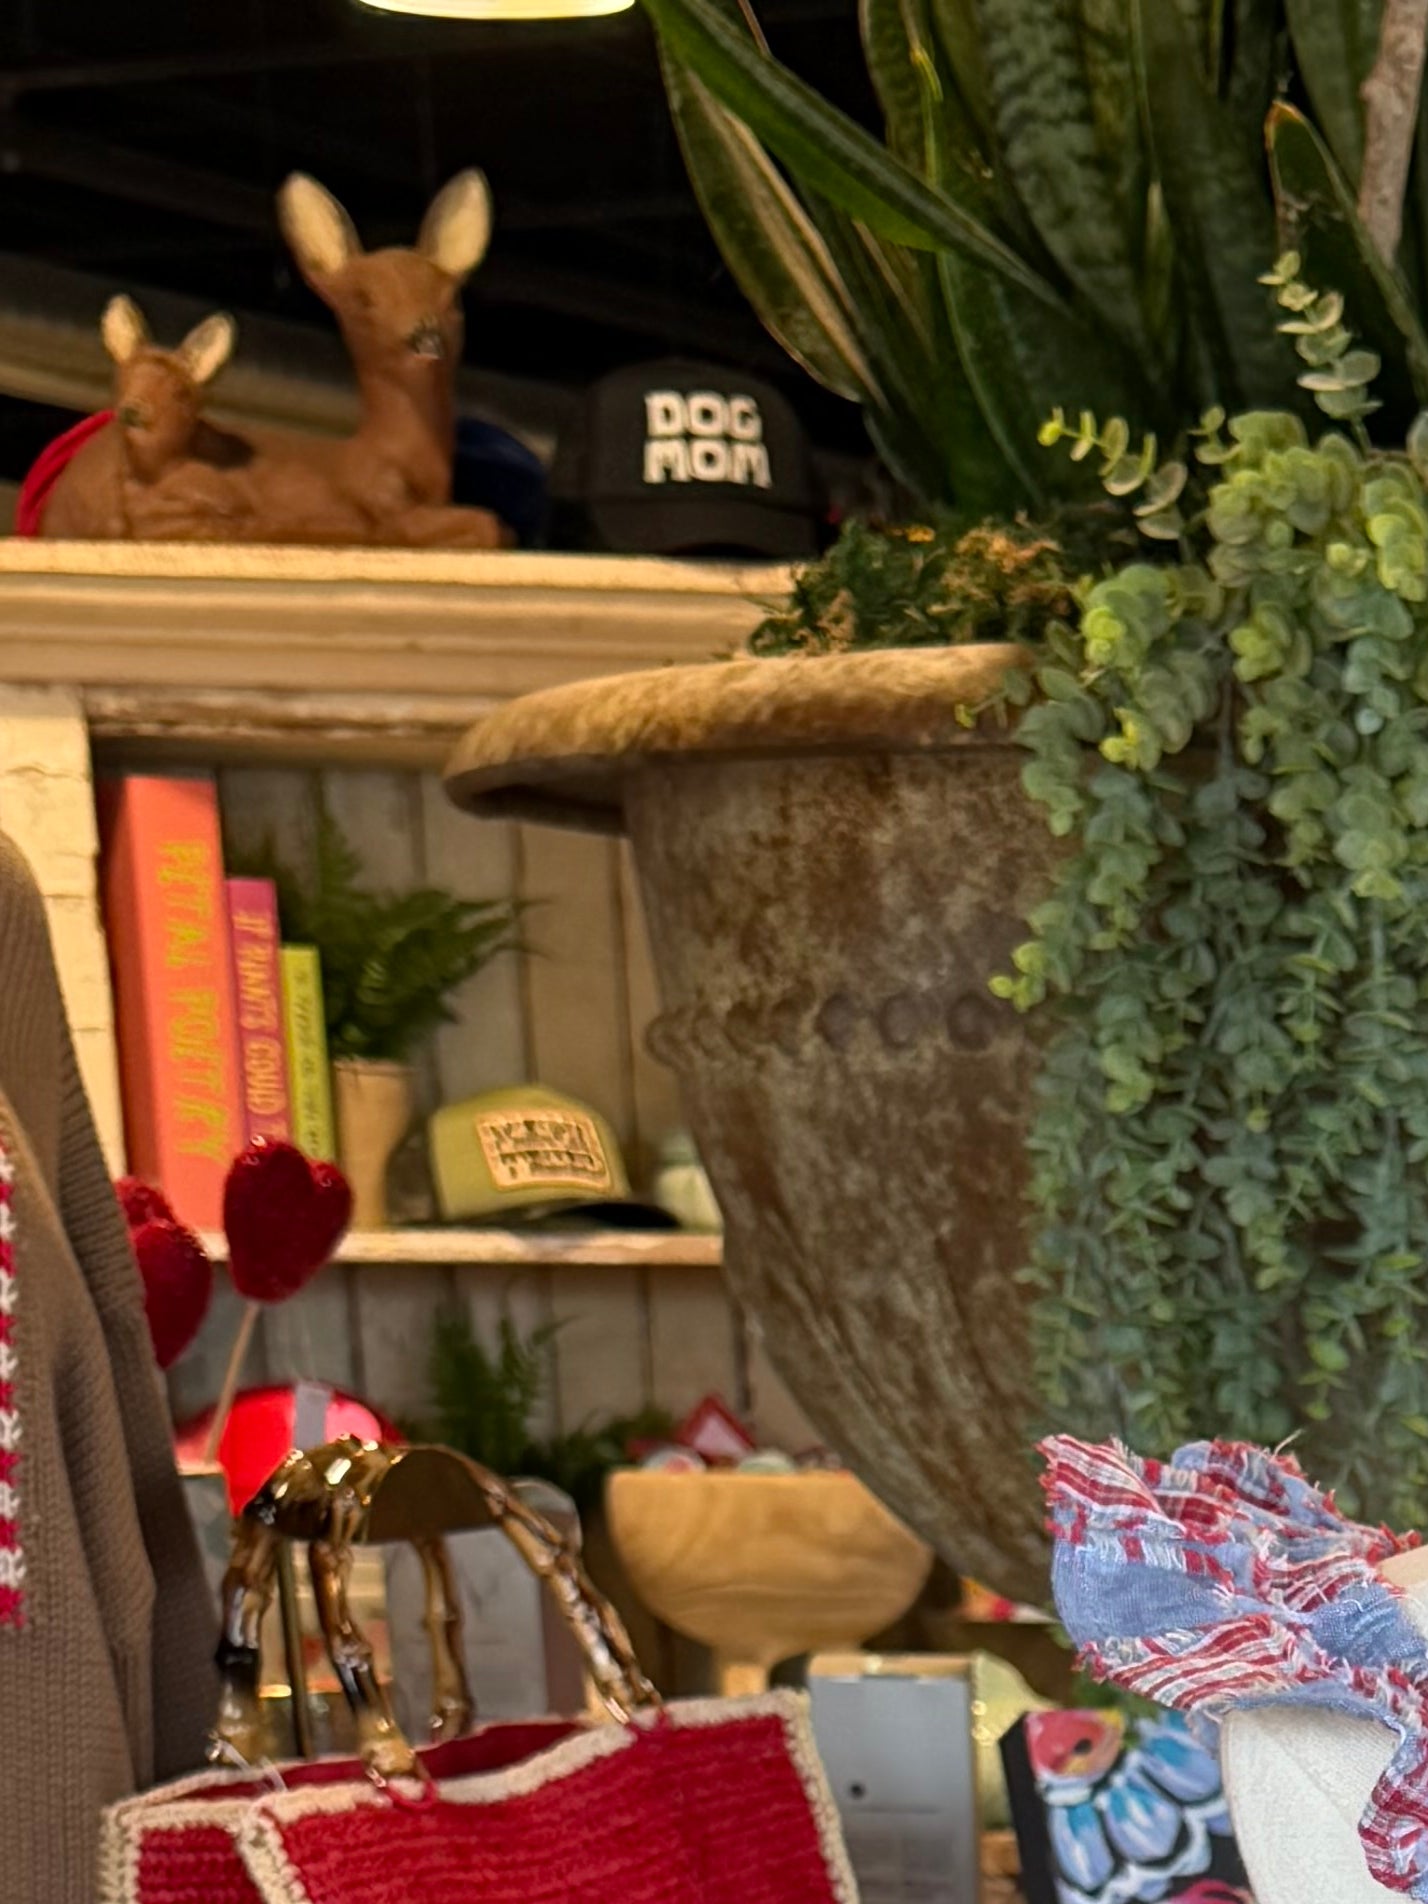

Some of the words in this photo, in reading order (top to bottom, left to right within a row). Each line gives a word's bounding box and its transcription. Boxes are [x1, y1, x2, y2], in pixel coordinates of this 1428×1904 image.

[643, 389, 763, 441] DOG
[642, 437, 773, 490] MOM
[170, 989, 230, 1162] POETRY
